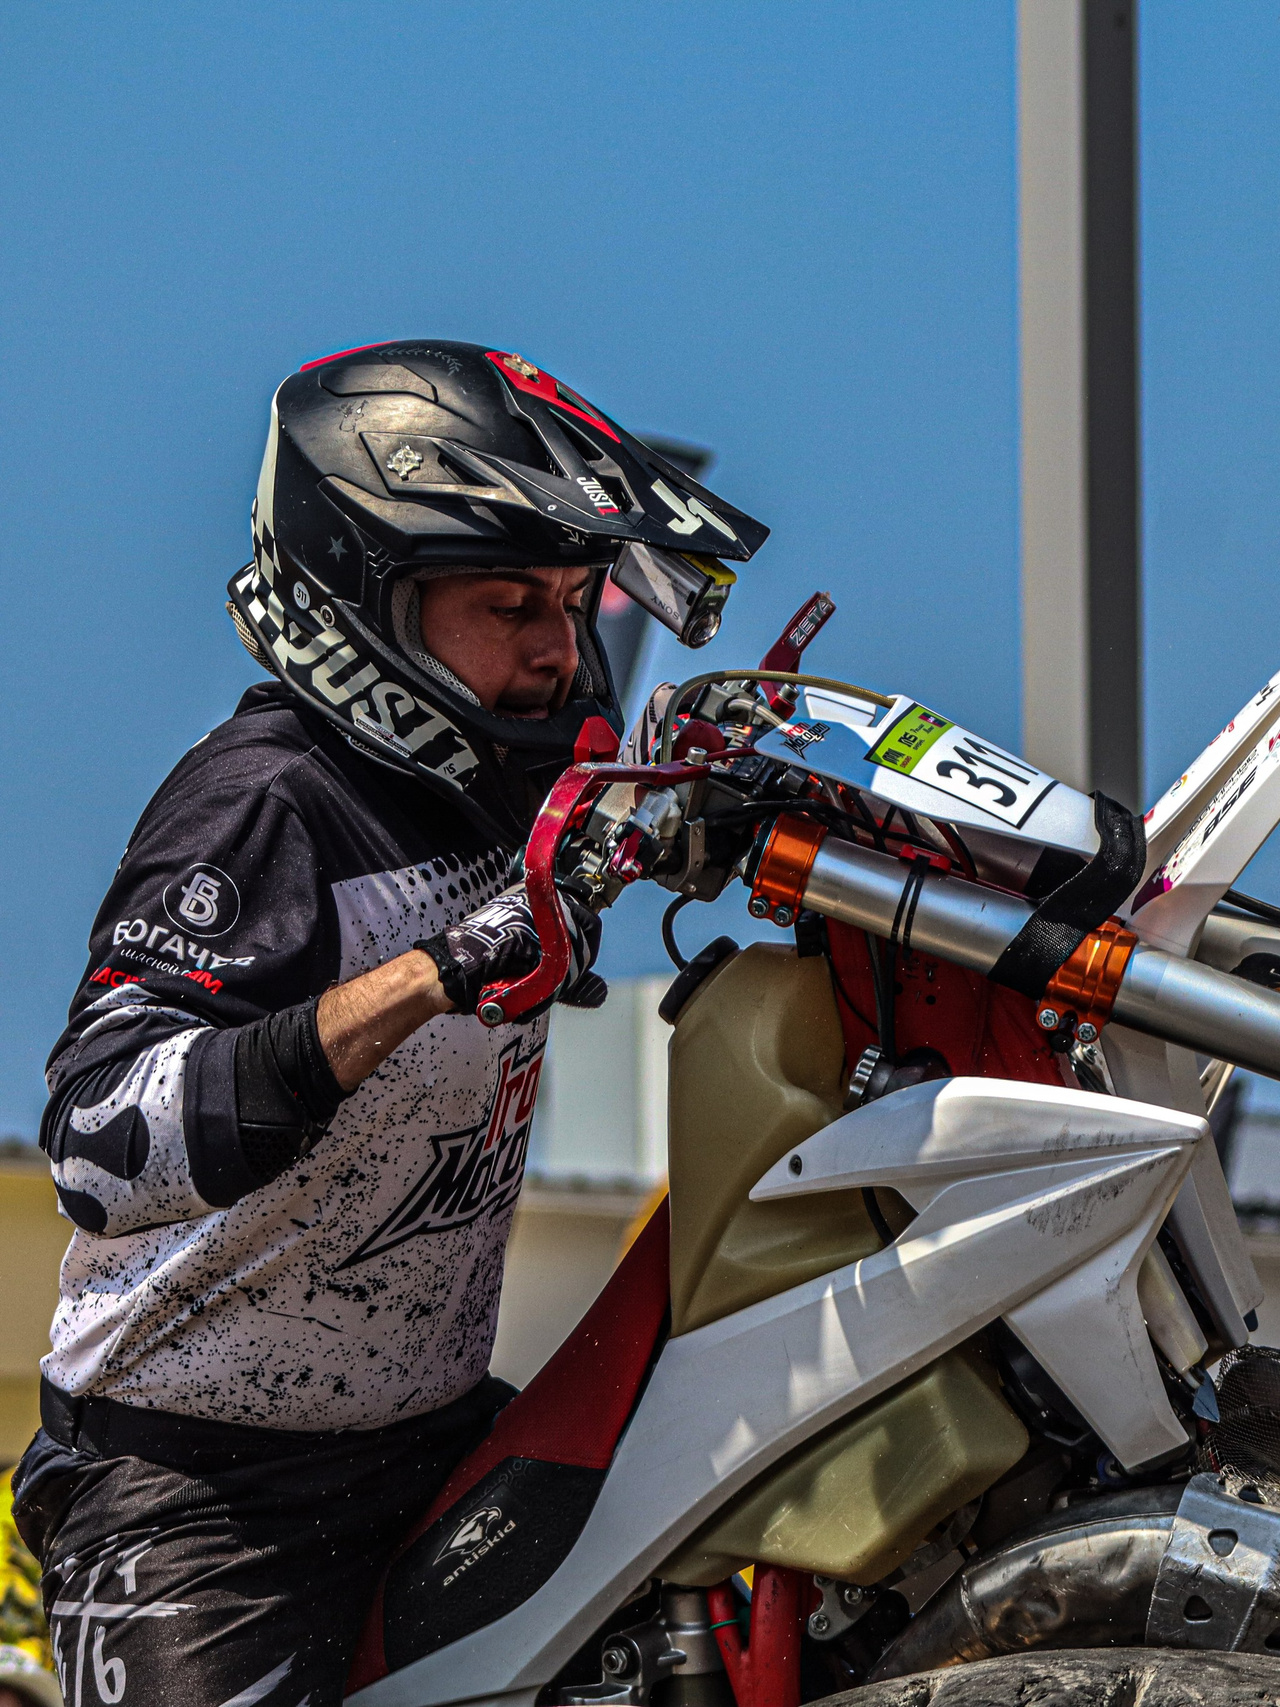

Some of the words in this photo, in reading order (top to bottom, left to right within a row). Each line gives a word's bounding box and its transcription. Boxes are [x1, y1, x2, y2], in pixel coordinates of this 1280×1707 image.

[651, 595, 680, 620] SONY
[790, 598, 833, 648] ZETA
[936, 736, 1039, 808] 311
[443, 1519, 517, 1587] antiskid
